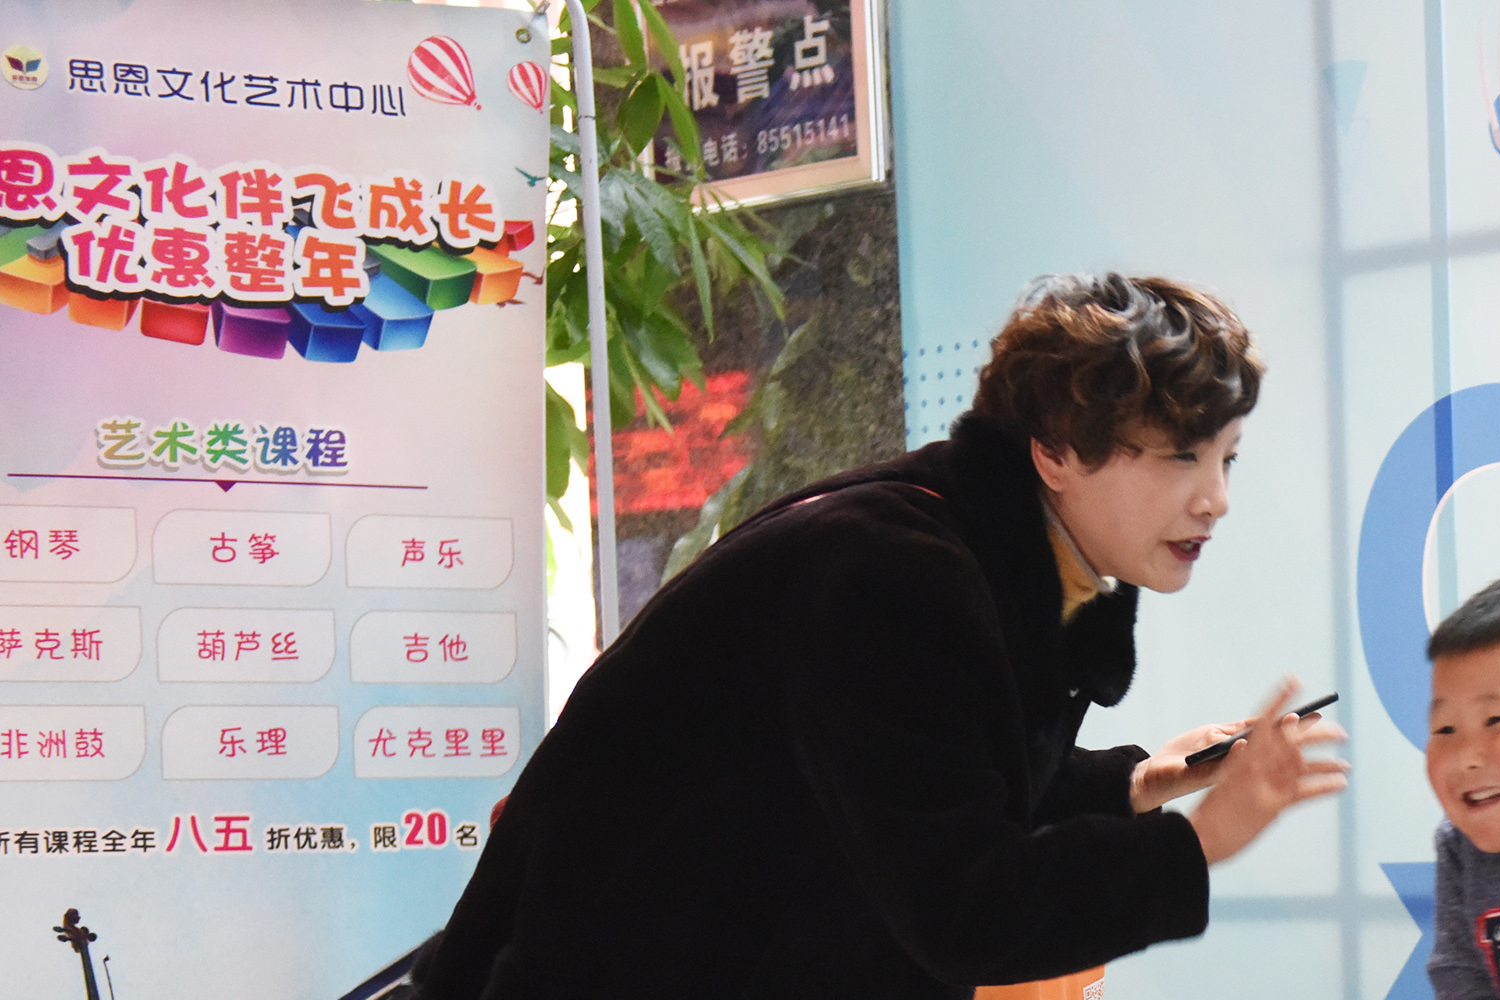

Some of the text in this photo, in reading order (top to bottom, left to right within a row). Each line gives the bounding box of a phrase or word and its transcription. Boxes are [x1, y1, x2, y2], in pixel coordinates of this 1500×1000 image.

[680, 15, 836, 111] 报警点
[68, 57, 407, 117] 思恩文化艺术中心
[0, 149, 498, 239] 恩文化伴飞成长
[71, 227, 363, 297] 优惠整年
[100, 420, 349, 469] 艺术类课程
[4, 529, 82, 561] 钢琴
[209, 532, 281, 564] 古筝
[400, 538, 466, 569] 声乐
[0, 628, 103, 661] 萨克斯
[197, 630, 300, 662] 葫芦丝
[404, 633, 470, 664] 吉他
[1, 728, 105, 759] 非洲鼓
[218, 728, 288, 757] 乐理
[368, 728, 509, 759] 尤克里里
